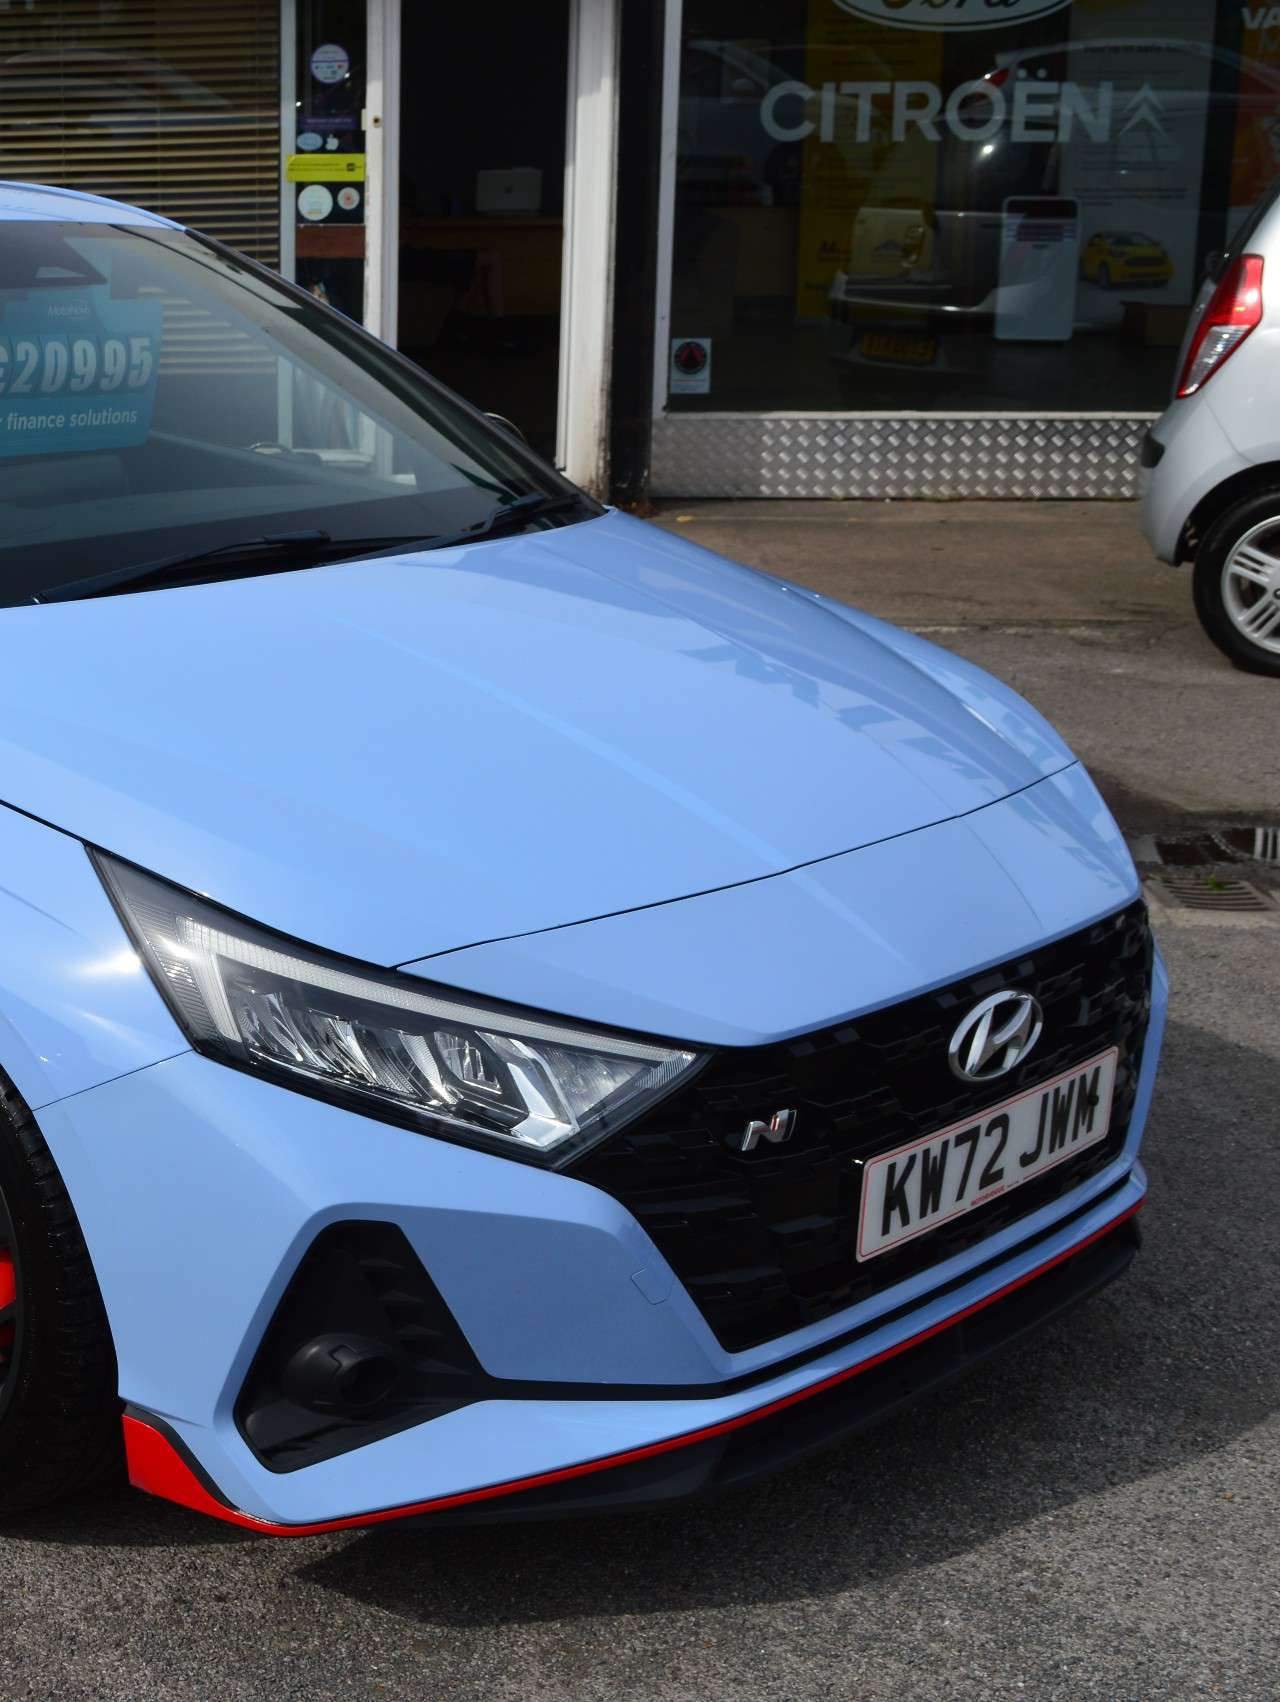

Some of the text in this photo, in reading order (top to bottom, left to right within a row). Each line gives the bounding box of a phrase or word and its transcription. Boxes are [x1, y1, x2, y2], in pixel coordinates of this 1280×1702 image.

[760, 67, 1113, 144] CITROËN
[7, 411, 65, 431] finance
[69, 407, 137, 428] solutions
[880, 1065, 1102, 1237] KW72 JWM
